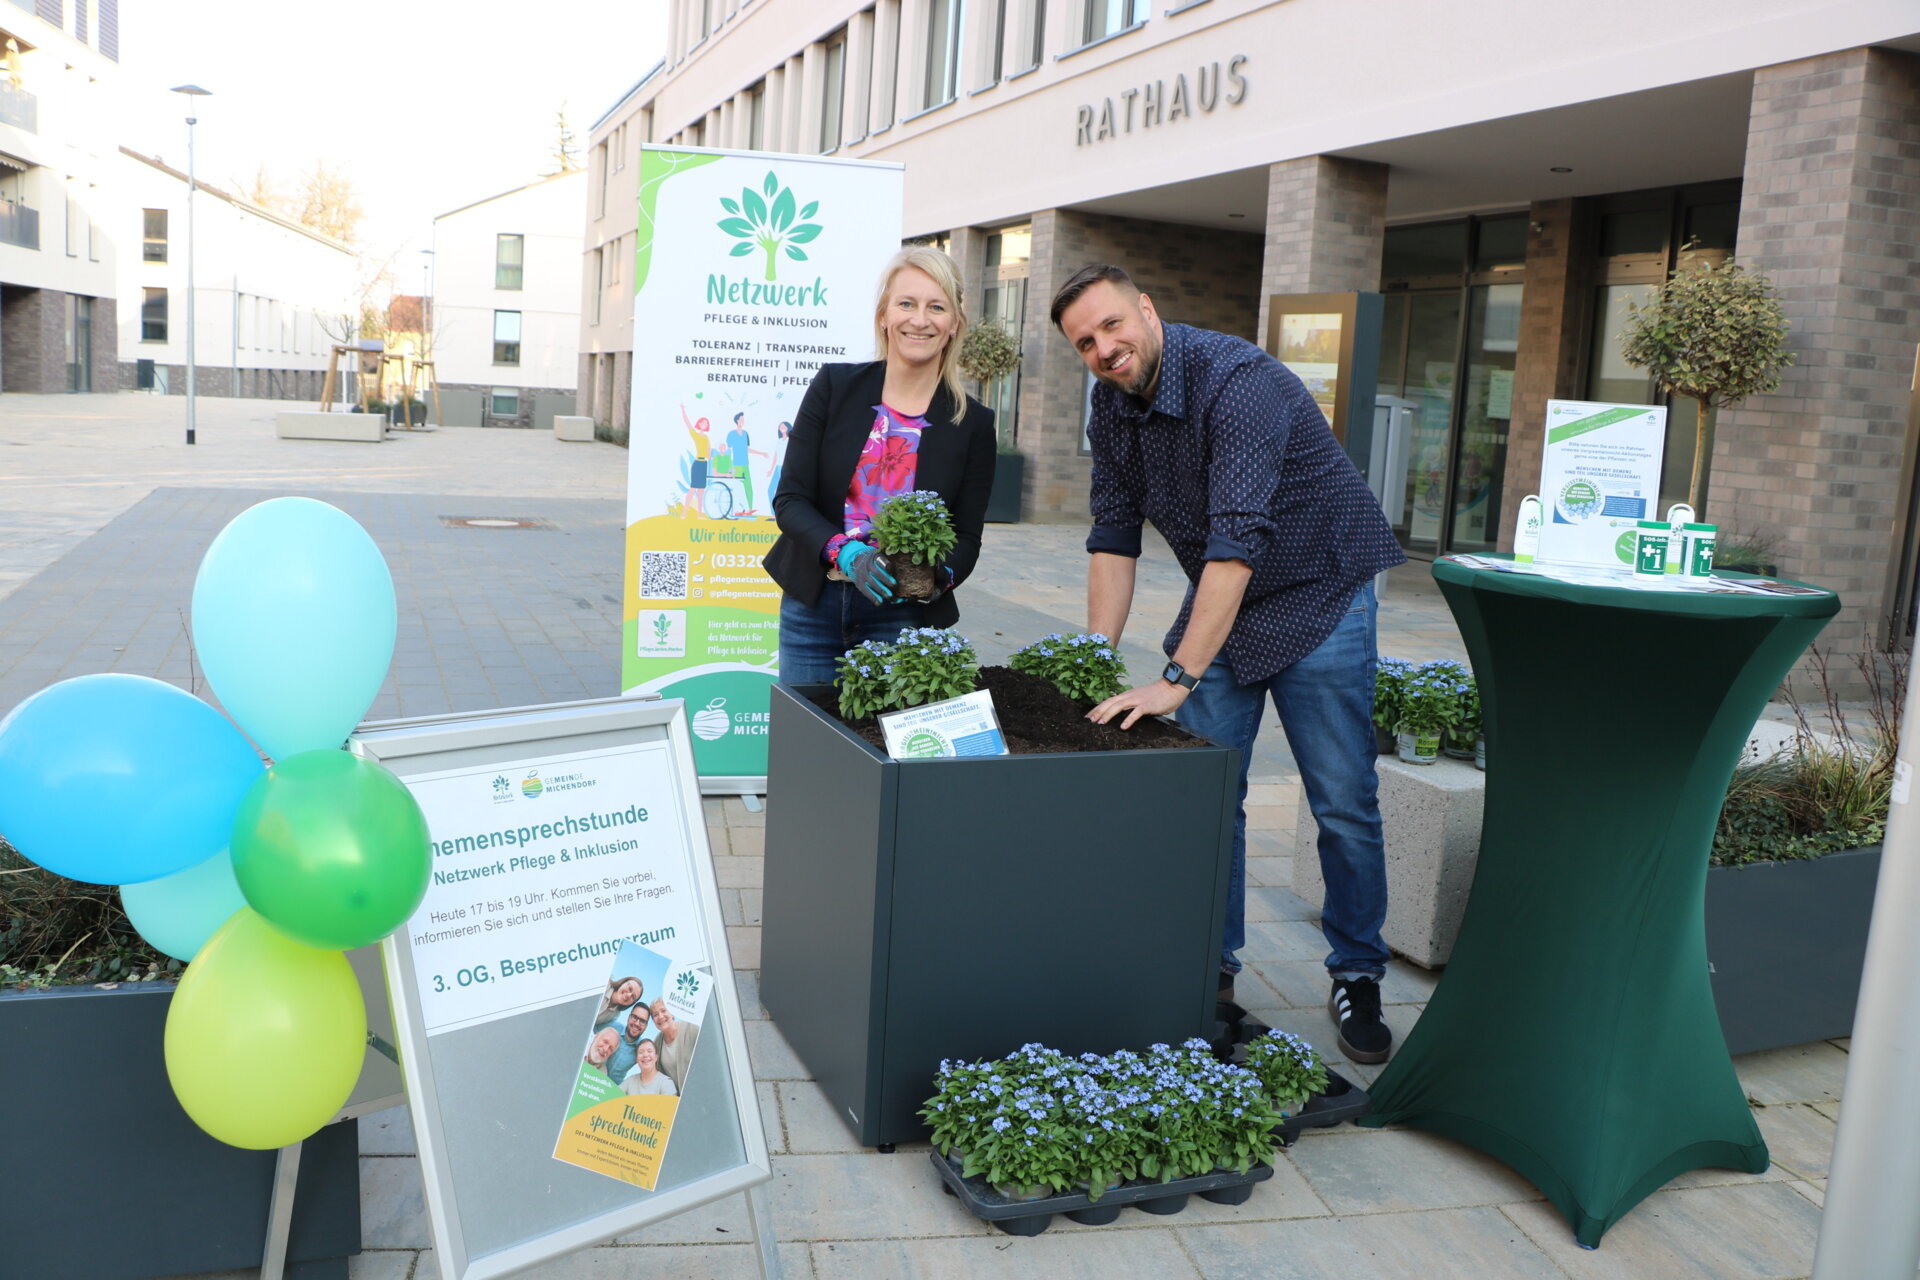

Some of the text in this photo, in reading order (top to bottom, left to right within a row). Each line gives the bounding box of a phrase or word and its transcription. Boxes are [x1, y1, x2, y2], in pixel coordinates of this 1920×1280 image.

[1076, 54, 1248, 146] RATHAUS
[707, 273, 828, 307] Netzwerk
[704, 313, 828, 328] PFLEGE & INKLUSION
[692, 340, 846, 355] TOLERANZ TRANSPARENZ
[675, 355, 823, 370] BARRIEREFREIHEIT INKL
[707, 373, 768, 384] BERATUNG
[689, 528, 781, 543] Wir informier
[708, 620, 723, 629] Hier
[725, 621, 739, 630] geht
[720, 633, 751, 642] Netzwerk
[707, 645, 729, 656] Pflege
[737, 646, 768, 655] Inklusion
[734, 712, 770, 722] GEME
[734, 725, 769, 735] MICH
[544, 773, 584, 785] GEMEINDE
[546, 780, 597, 793] MICHENDORF
[432, 804, 649, 857] emensprechstunde
[434, 839, 639, 886] Netzwerk Pflege & Inklusion
[430, 870, 657, 924] Heute 17 bis 19 Uhr. Kommen Sie vorbei,
[414, 884, 675, 946] informieren Sie sich und stellen Sie Ihre Fragen.
[433, 926, 676, 993] 3. OG, Besprechungraum
[669, 991, 696, 1009] Netzwerk
[622, 1104, 668, 1132] Themen-
[589, 1114, 659, 1149] sprechstunde
[585, 1132, 609, 1145] NETZWERK
[629, 1149, 653, 1161] INKLUSION
